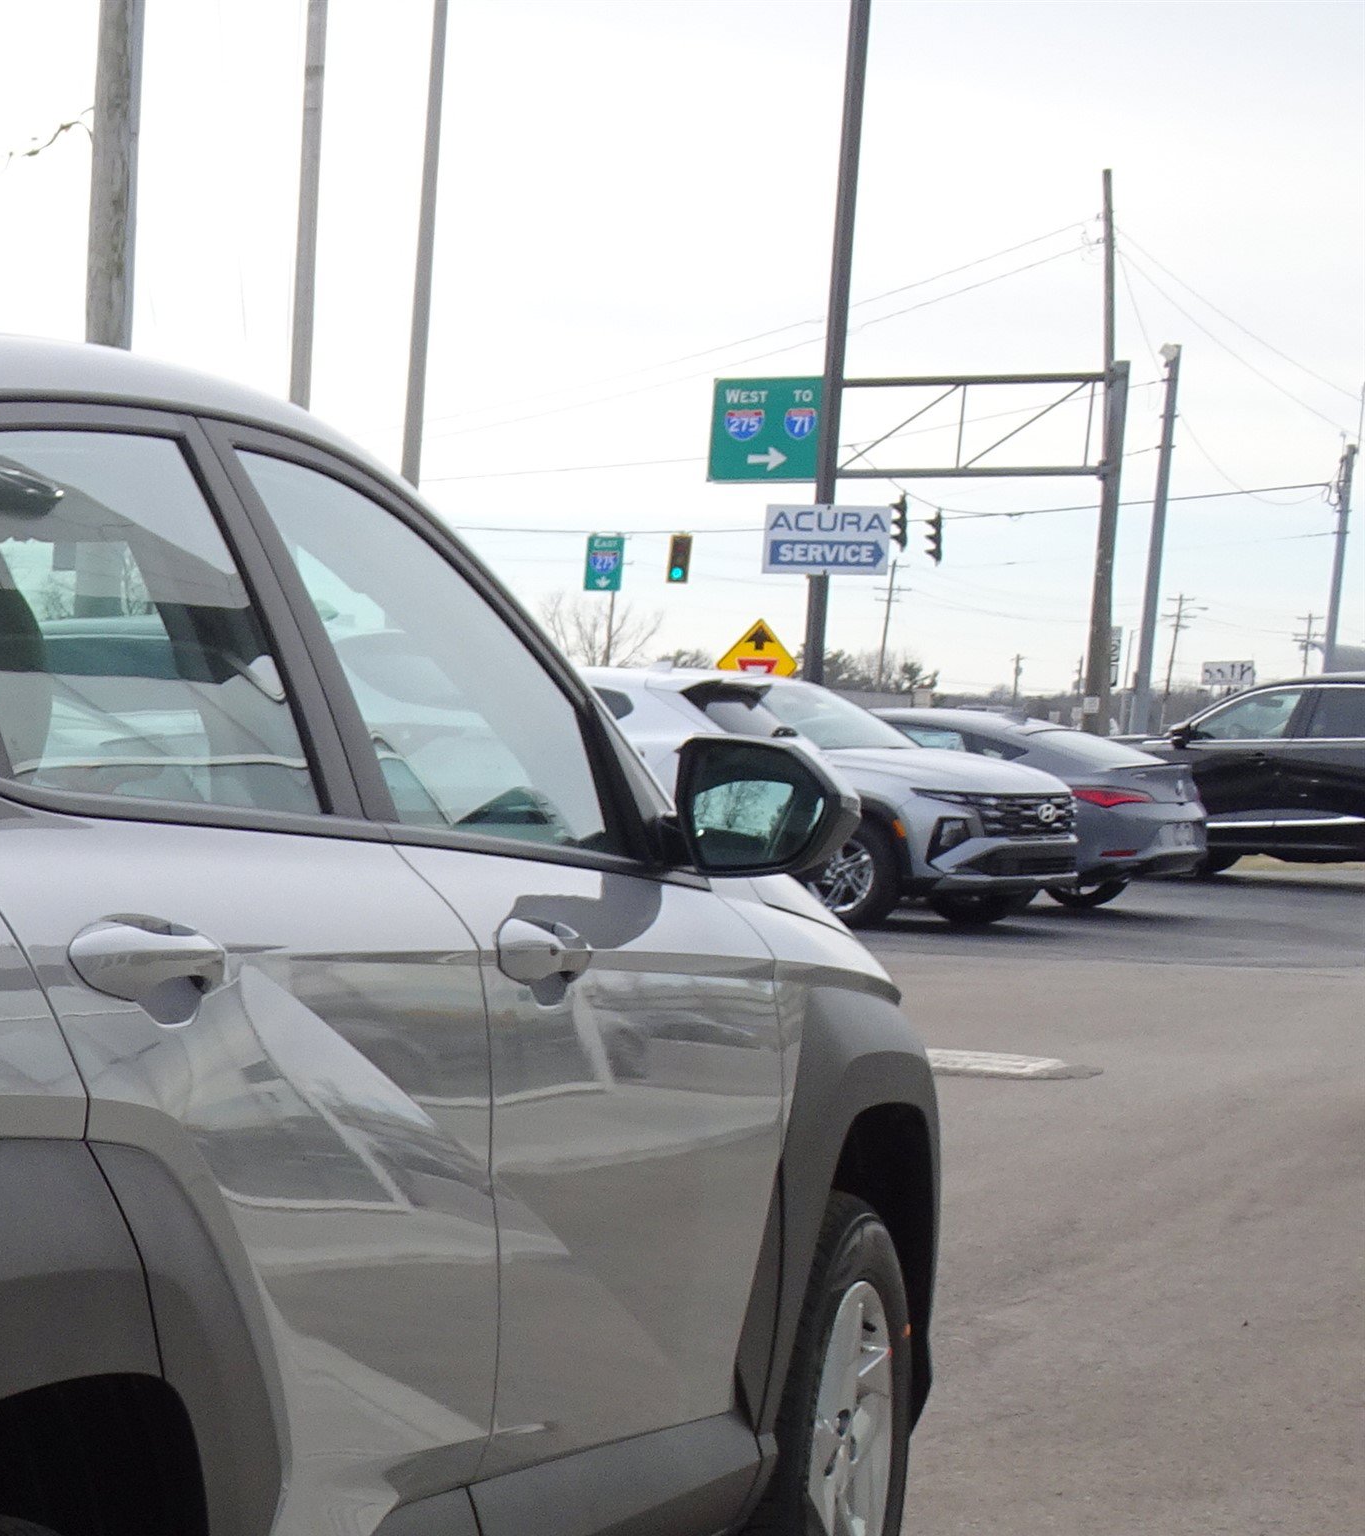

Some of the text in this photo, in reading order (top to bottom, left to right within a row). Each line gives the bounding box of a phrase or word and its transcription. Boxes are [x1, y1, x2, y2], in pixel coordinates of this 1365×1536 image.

[725, 388, 813, 404] WEST TO
[729, 416, 810, 433] 275 71
[770, 511, 887, 532] ACURA
[778, 543, 875, 562] SERVICE
